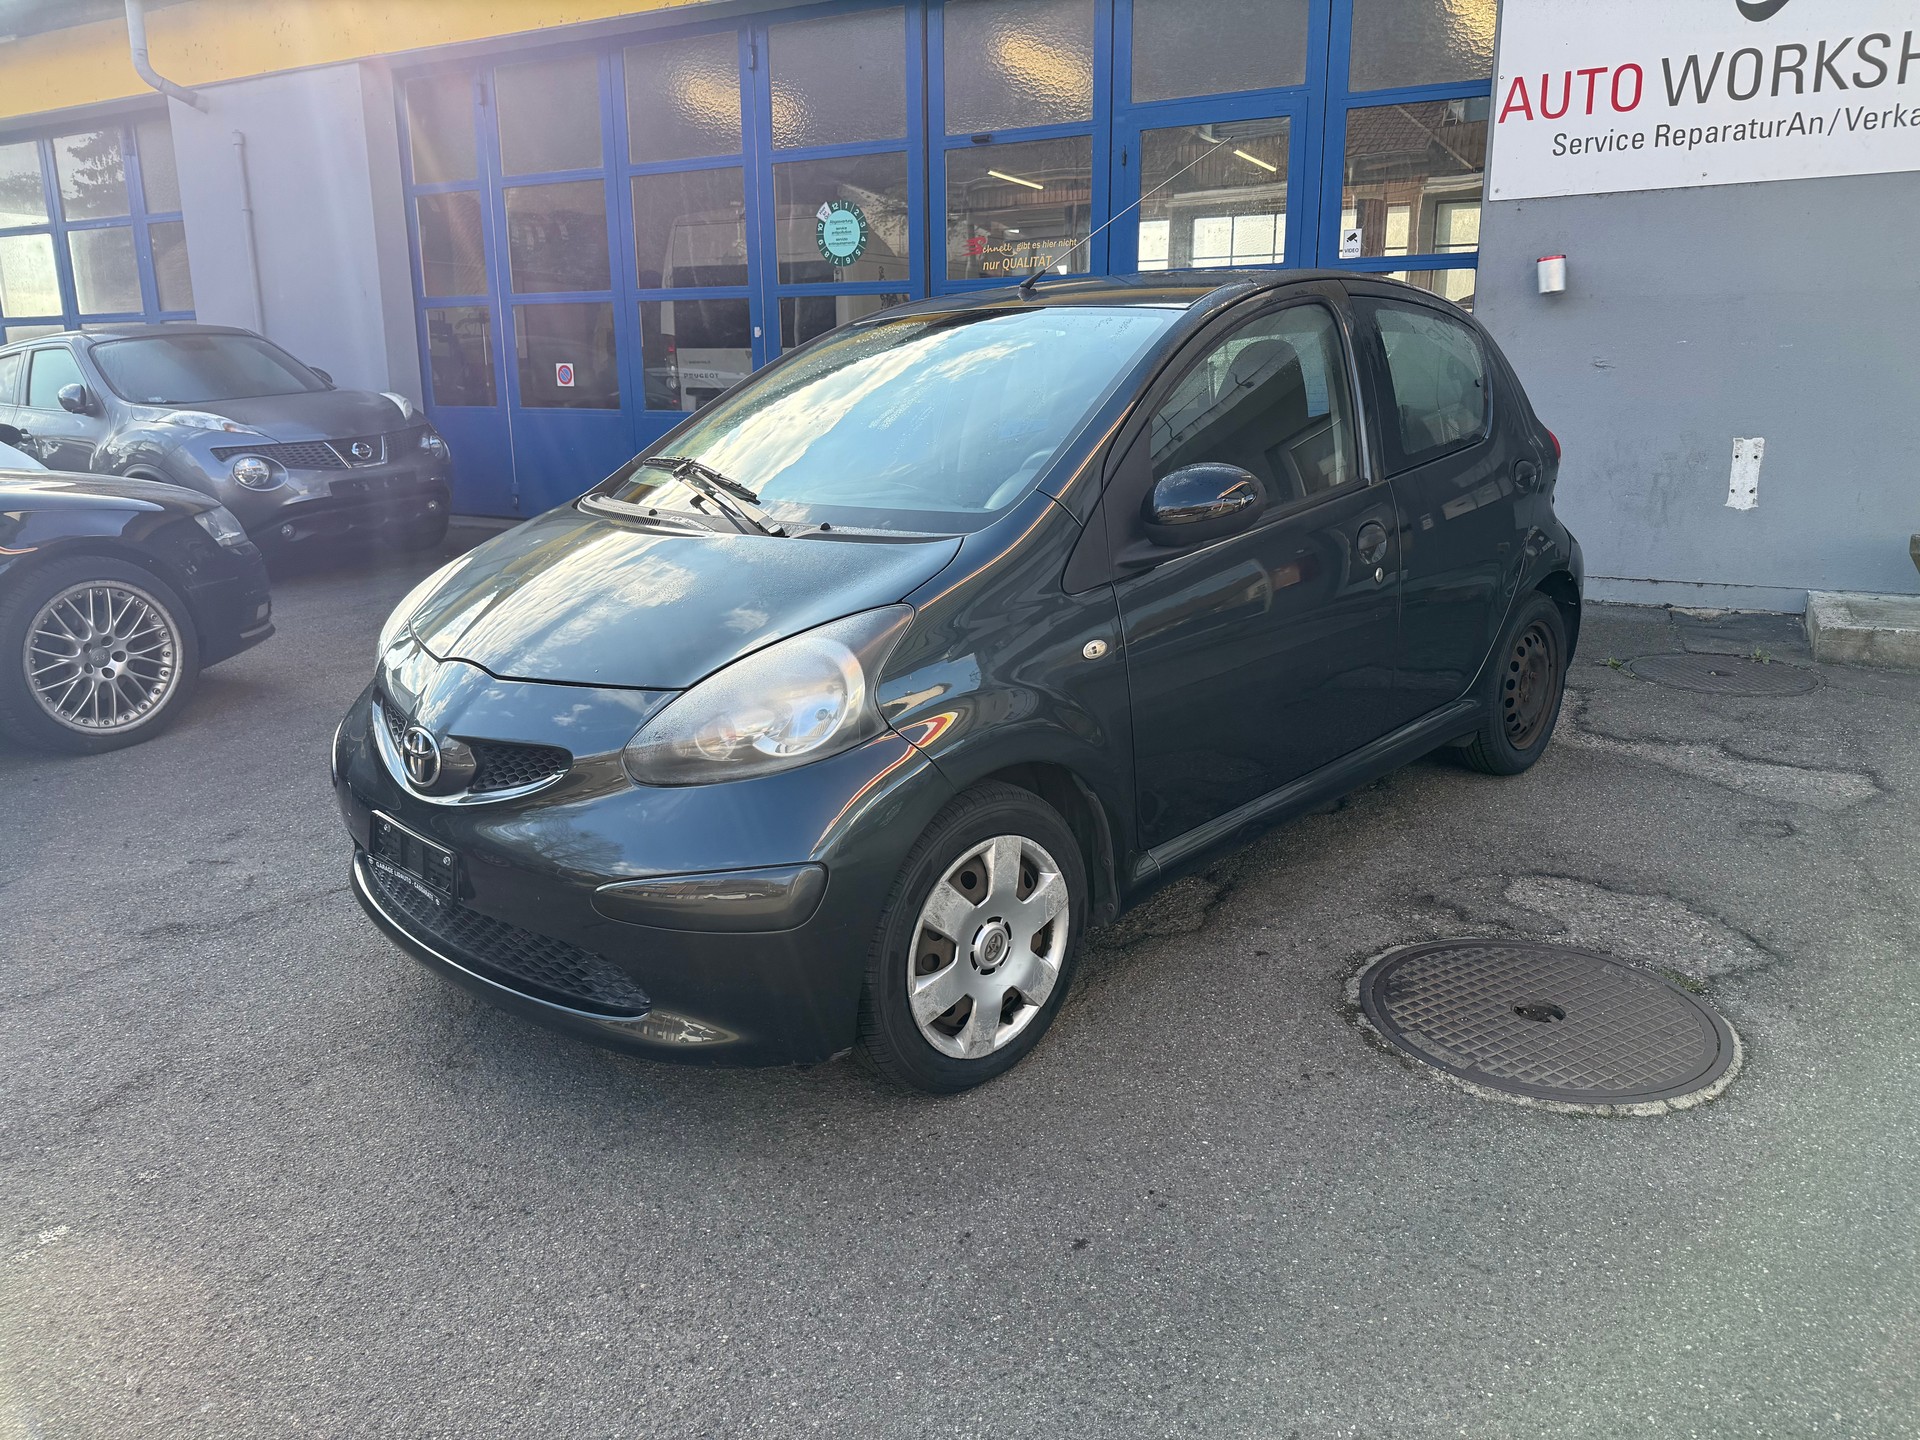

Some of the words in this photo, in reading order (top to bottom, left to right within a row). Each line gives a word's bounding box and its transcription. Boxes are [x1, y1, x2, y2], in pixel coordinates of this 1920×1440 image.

[1498, 63, 1643, 123] AUTO
[1552, 128, 1645, 157] Service
[1016, 241, 1031, 251] gibt
[1042, 240, 1057, 248] hier
[1058, 238, 1077, 247] nicht
[983, 261, 1000, 270] nur
[1002, 254, 1052, 271] QUALITÄT
